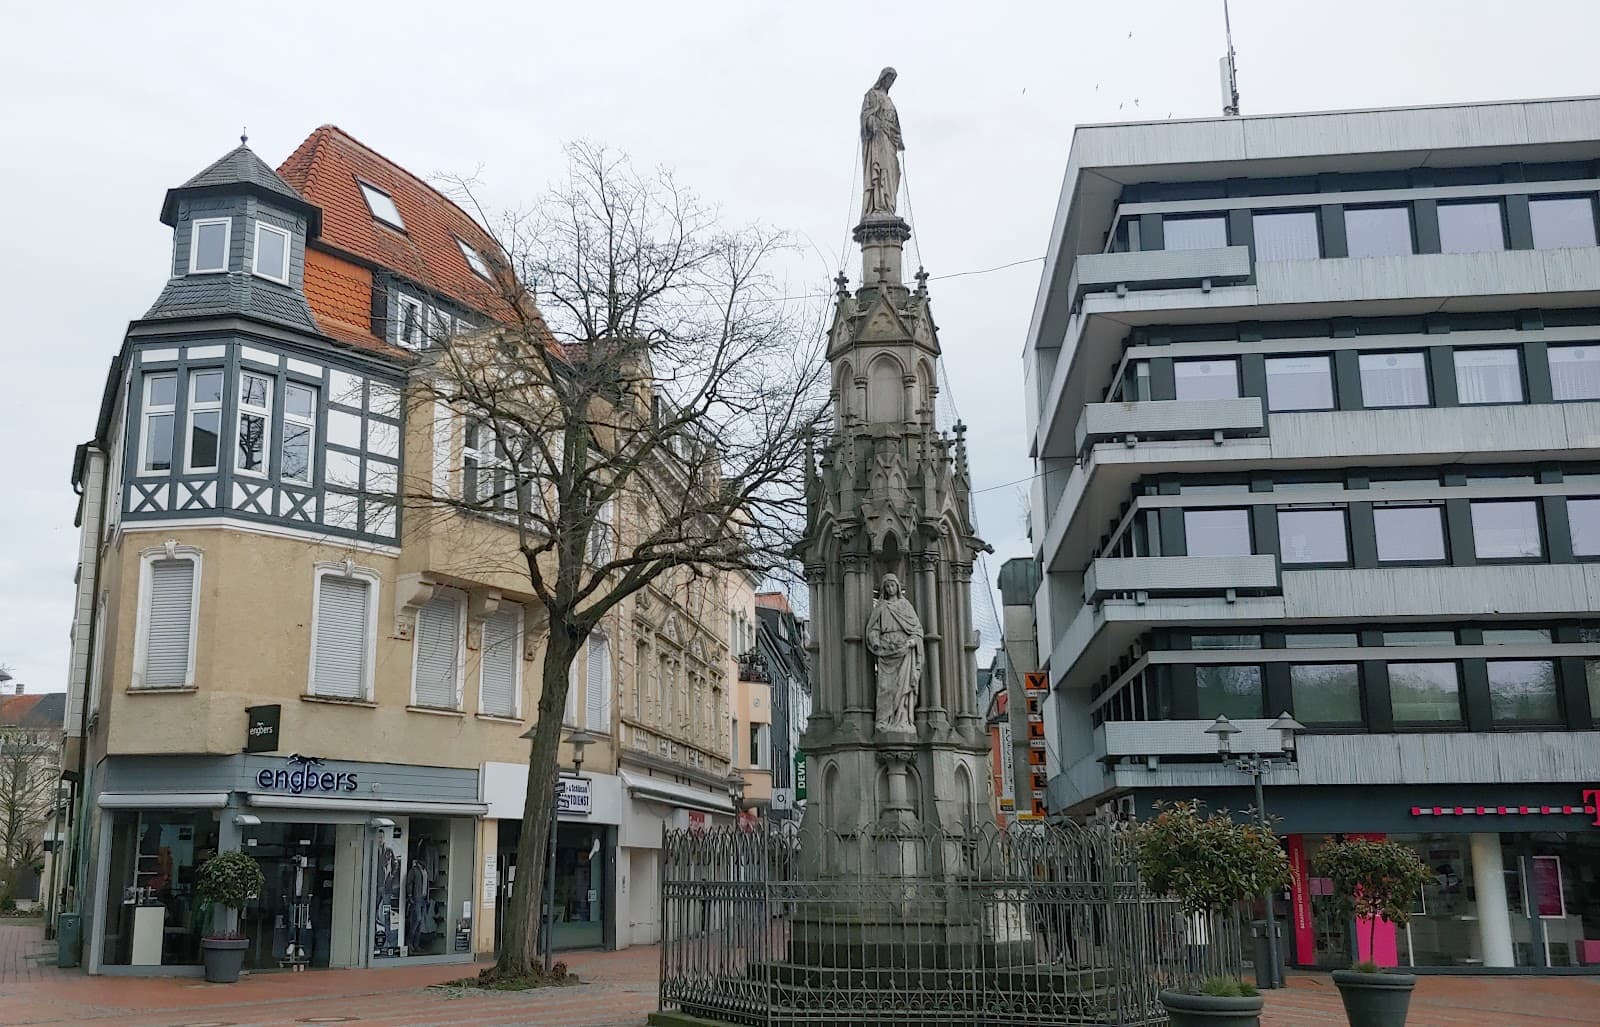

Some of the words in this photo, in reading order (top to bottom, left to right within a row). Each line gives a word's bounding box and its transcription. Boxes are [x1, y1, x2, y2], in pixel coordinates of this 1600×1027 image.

[250, 724, 273, 737] engbers
[256, 762, 358, 794] engbers
[797, 760, 806, 789] DEVK
